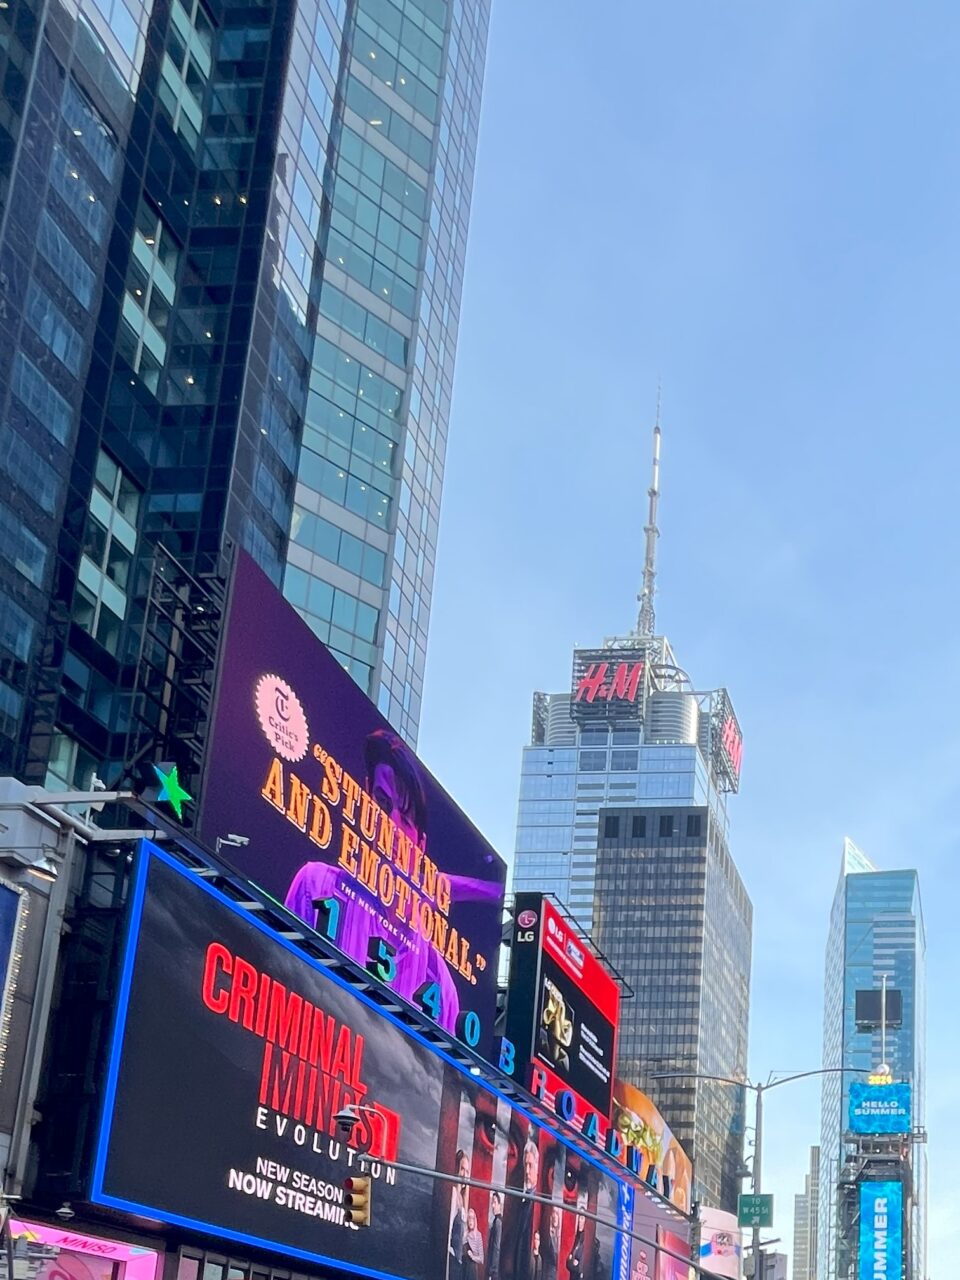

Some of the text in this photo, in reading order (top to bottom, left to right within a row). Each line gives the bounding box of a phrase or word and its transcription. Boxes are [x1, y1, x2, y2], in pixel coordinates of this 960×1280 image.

[575, 662, 644, 703] H&M
[268, 716, 299, 742] Critic's
[274, 731, 295, 752] Pick
[261, 757, 332, 850] AND
[341, 882, 420, 955] THE NEW YORK TIMES
[517, 931, 535, 943] LG
[202, 942, 368, 1095] CRIMINAL
[259, 1041, 380, 1161] MINS
[854, 1108, 906, 1116] SUMMER
[861, 1100, 899, 1108] HELLO
[228, 1168, 272, 1200] NOW
[256, 1156, 344, 1205] NEW SEASON
[751, 1197, 761, 1205] TO
[57, 1236, 118, 1255] MINISO
